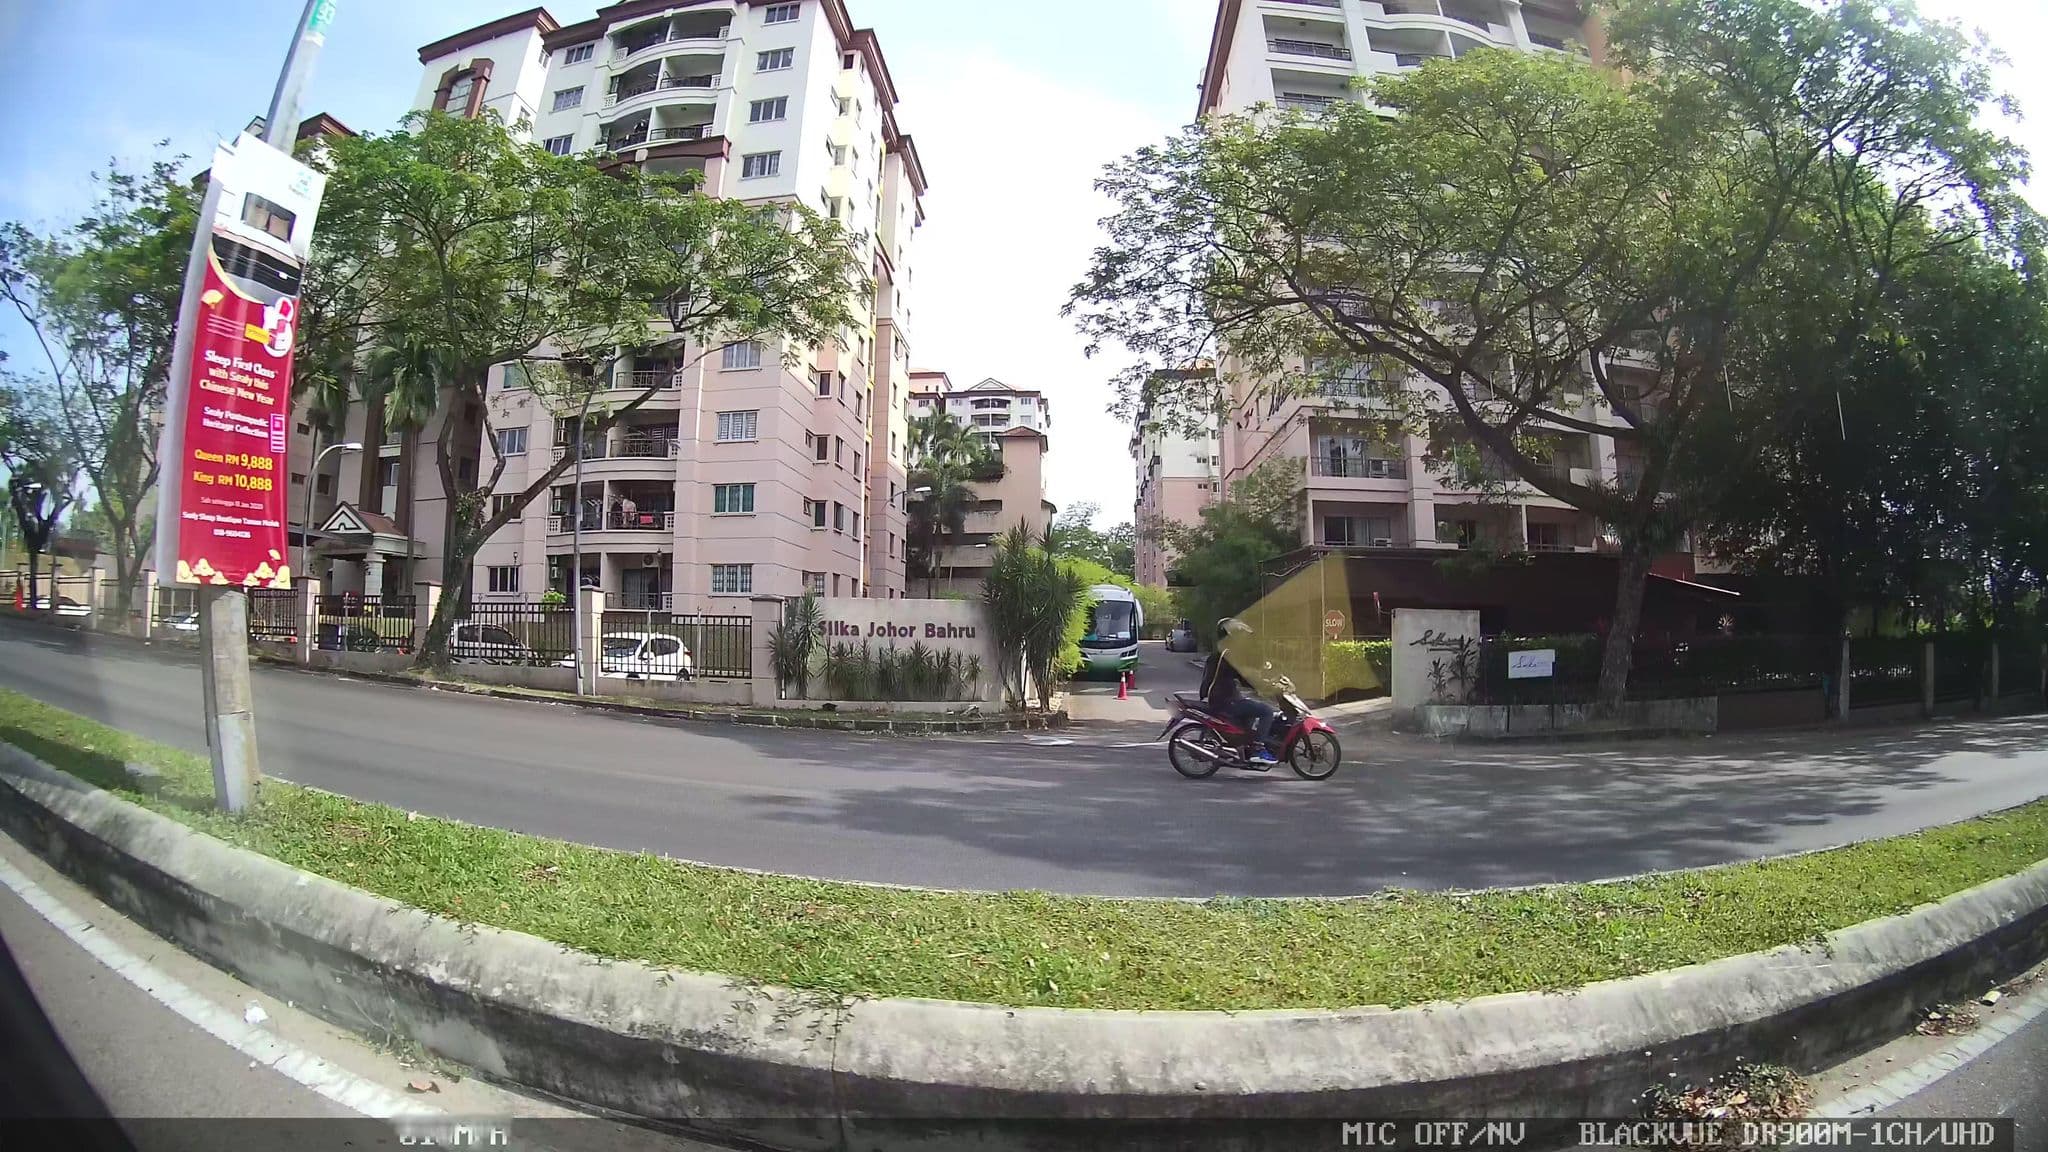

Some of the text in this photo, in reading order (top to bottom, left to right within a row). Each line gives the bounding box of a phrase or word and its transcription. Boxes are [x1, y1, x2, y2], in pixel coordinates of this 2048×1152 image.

[205, 350, 275, 379] Sleep First Class
[208, 367, 270, 390] with Sealy this
[199, 379, 275, 405] Chinese New Year
[203, 406, 224, 419] Sealy
[202, 418, 269, 438] Heritage Collection
[195, 449, 273, 470] Queen RM 9,888
[193, 471, 273, 491] King RM 10,888
[818, 620, 976, 639] Silka Johor Bahru
[1325, 618, 1343, 627] SLOW
